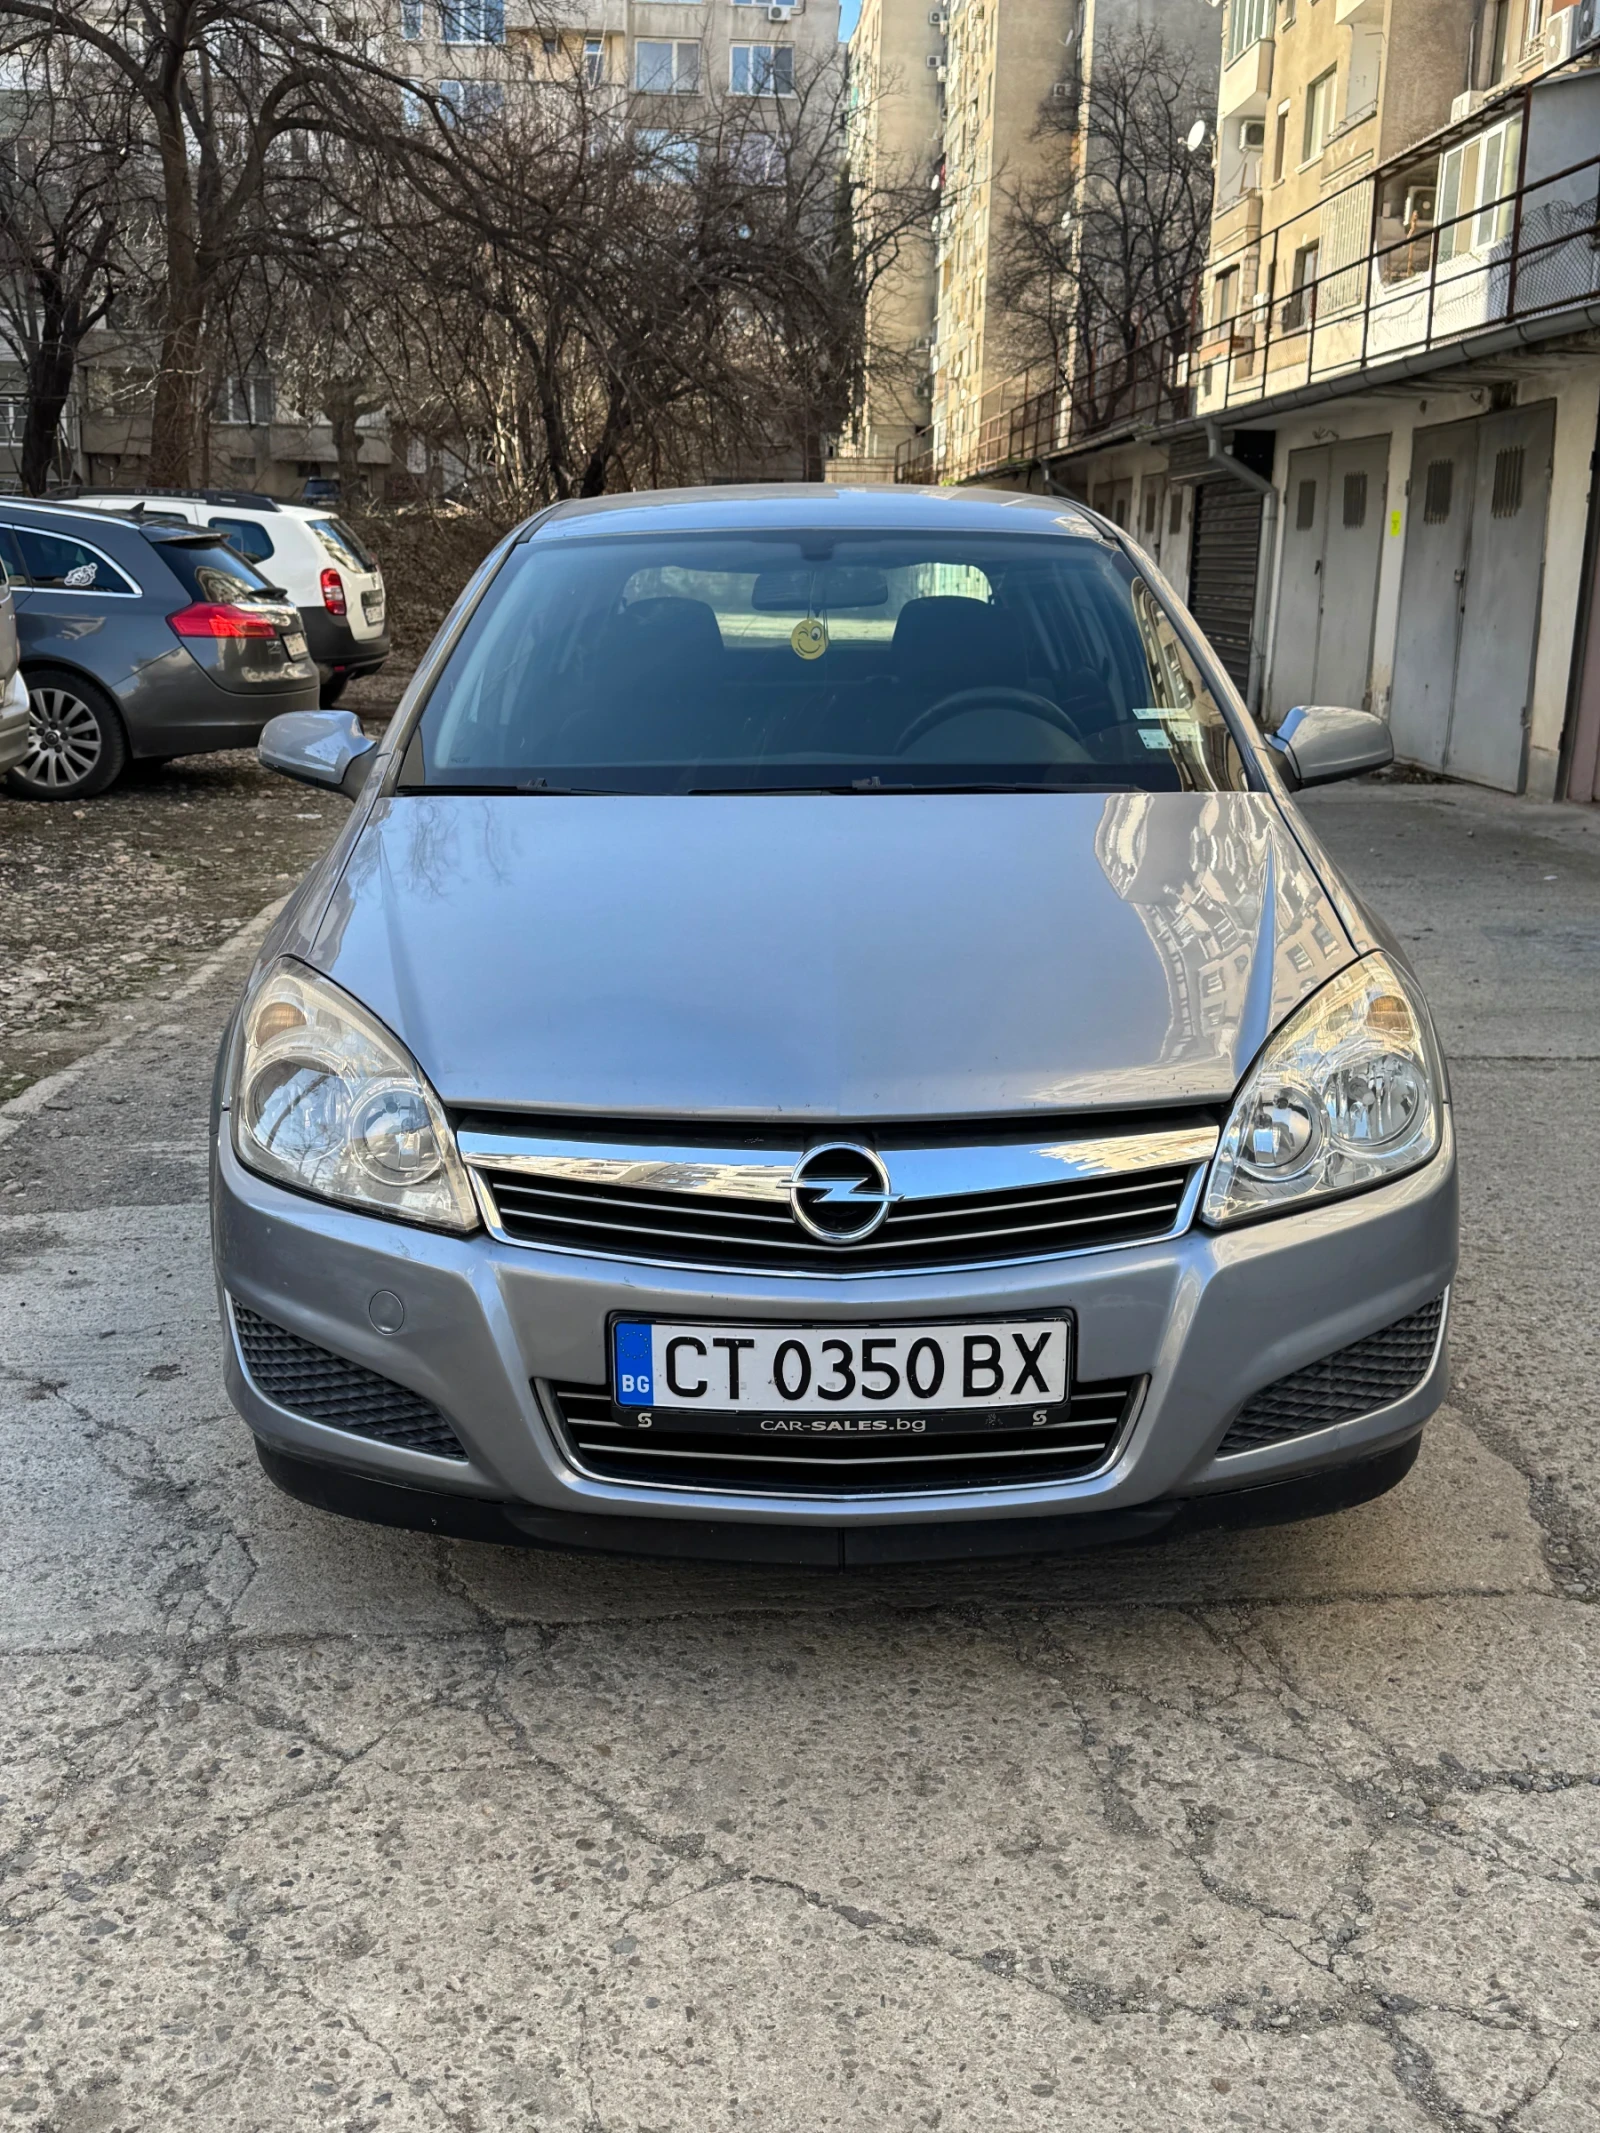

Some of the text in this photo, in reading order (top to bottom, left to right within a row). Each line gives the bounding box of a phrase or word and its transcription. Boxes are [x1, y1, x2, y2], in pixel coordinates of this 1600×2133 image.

[134, 488, 200, 497] DUSTER
[665, 1332, 1052, 1400] CT 0350 BX
[622, 1374, 650, 1393] BG
[760, 1418, 926, 1432] CAR-SALES.bg
